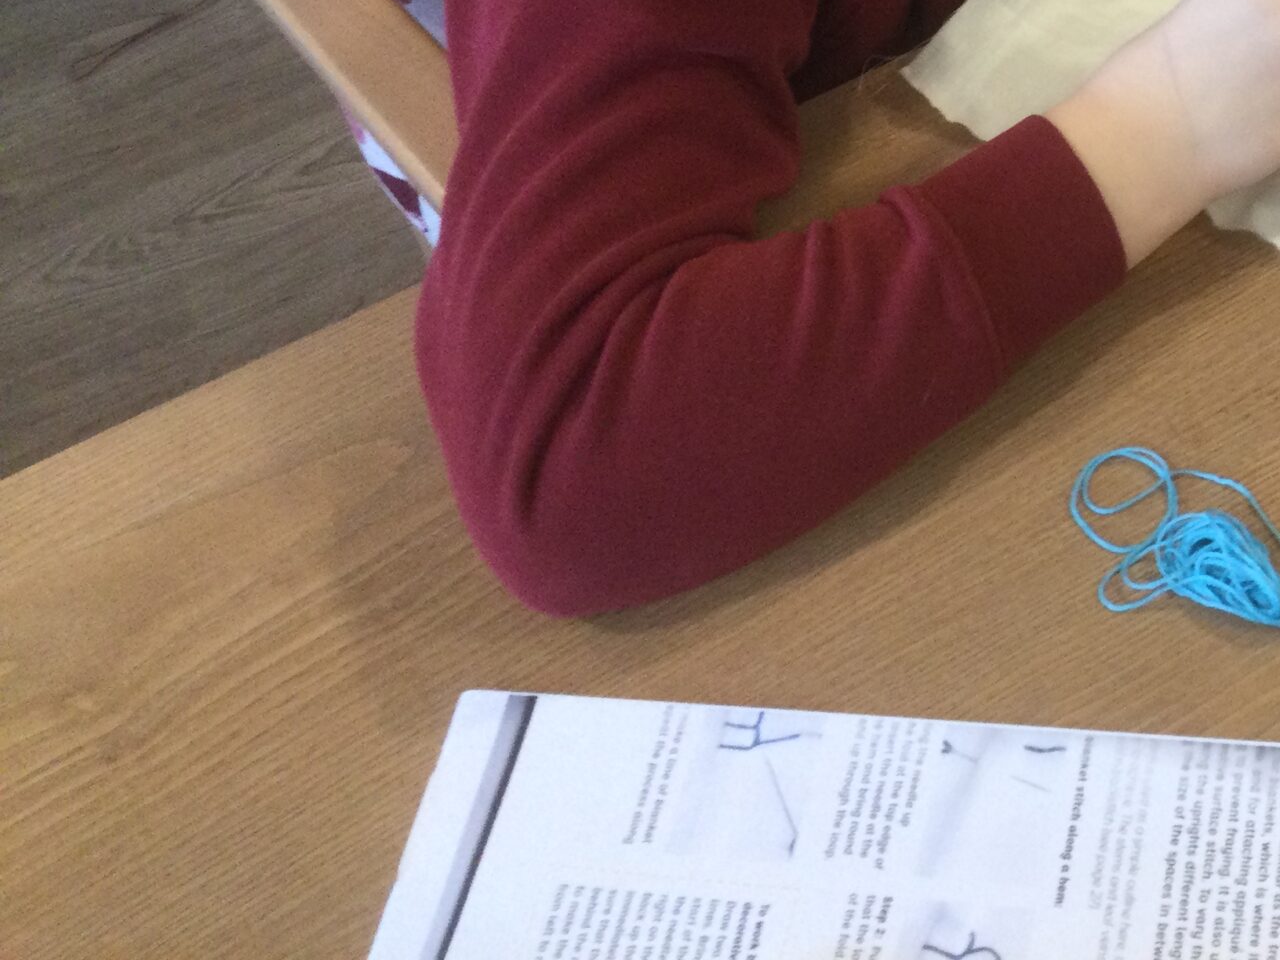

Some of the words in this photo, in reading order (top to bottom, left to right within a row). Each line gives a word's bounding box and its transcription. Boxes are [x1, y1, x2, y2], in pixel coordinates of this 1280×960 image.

[637, 762, 656, 807] process
[837, 760, 858, 805] through
[860, 762, 873, 784] and
[849, 787, 868, 817] bring
[869, 780, 884, 819] needle
[890, 780, 903, 799] the
[905, 770, 920, 808] needle
[884, 802, 898, 821] top
[1070, 786, 1084, 821] stitch
[1174, 806, 1184, 819] of
[622, 811, 642, 844] along
[643, 799, 663, 843] blanket
[833, 809, 846, 828] the
[899, 811, 910, 827] up
[1186, 800, 1201, 856] uprights
[843, 820, 858, 855] round
[876, 824, 891, 854] edge
[1059, 824, 1077, 860] along
[1170, 824, 1182, 845] the
[859, 838, 872, 858] the
[1234, 820, 1255, 885] attaching
[874, 857, 883, 869] of
[1060, 864, 1069, 872] a
[1162, 851, 1177, 898] spaces
[1258, 842, 1271, 882] which
[552, 883, 568, 911] from
[573, 885, 585, 897] to
[603, 889, 617, 915] sure
[847, 892, 858, 905] of
[1178, 861, 1195, 921] different
[1198, 888, 1211, 903] To
[1218, 885, 1229, 895] It
[1254, 887, 1267, 898] is
[561, 901, 578, 934] make
[581, 887, 602, 928] behind
[636, 892, 652, 920] back
[653, 894, 668, 922] right
[672, 896, 685, 915] the
[719, 900, 736, 930] Draw
[758, 903, 770, 917] To
[841, 908, 855, 929] the
[861, 894, 875, 919] that
[876, 896, 893, 923] Step
[1159, 903, 1171, 917] in
[1215, 900, 1227, 912] is
[543, 915, 556, 935] left
[594, 918, 609, 944] that
[628, 925, 640, 941] up
[647, 925, 658, 941] on
[749, 920, 763, 949] work
[855, 923, 869, 944] the
[1190, 908, 1205, 939] vary
[1211, 916, 1225, 947] also
[1249, 904, 1263, 947] where
[573, 932, 587, 952] the
